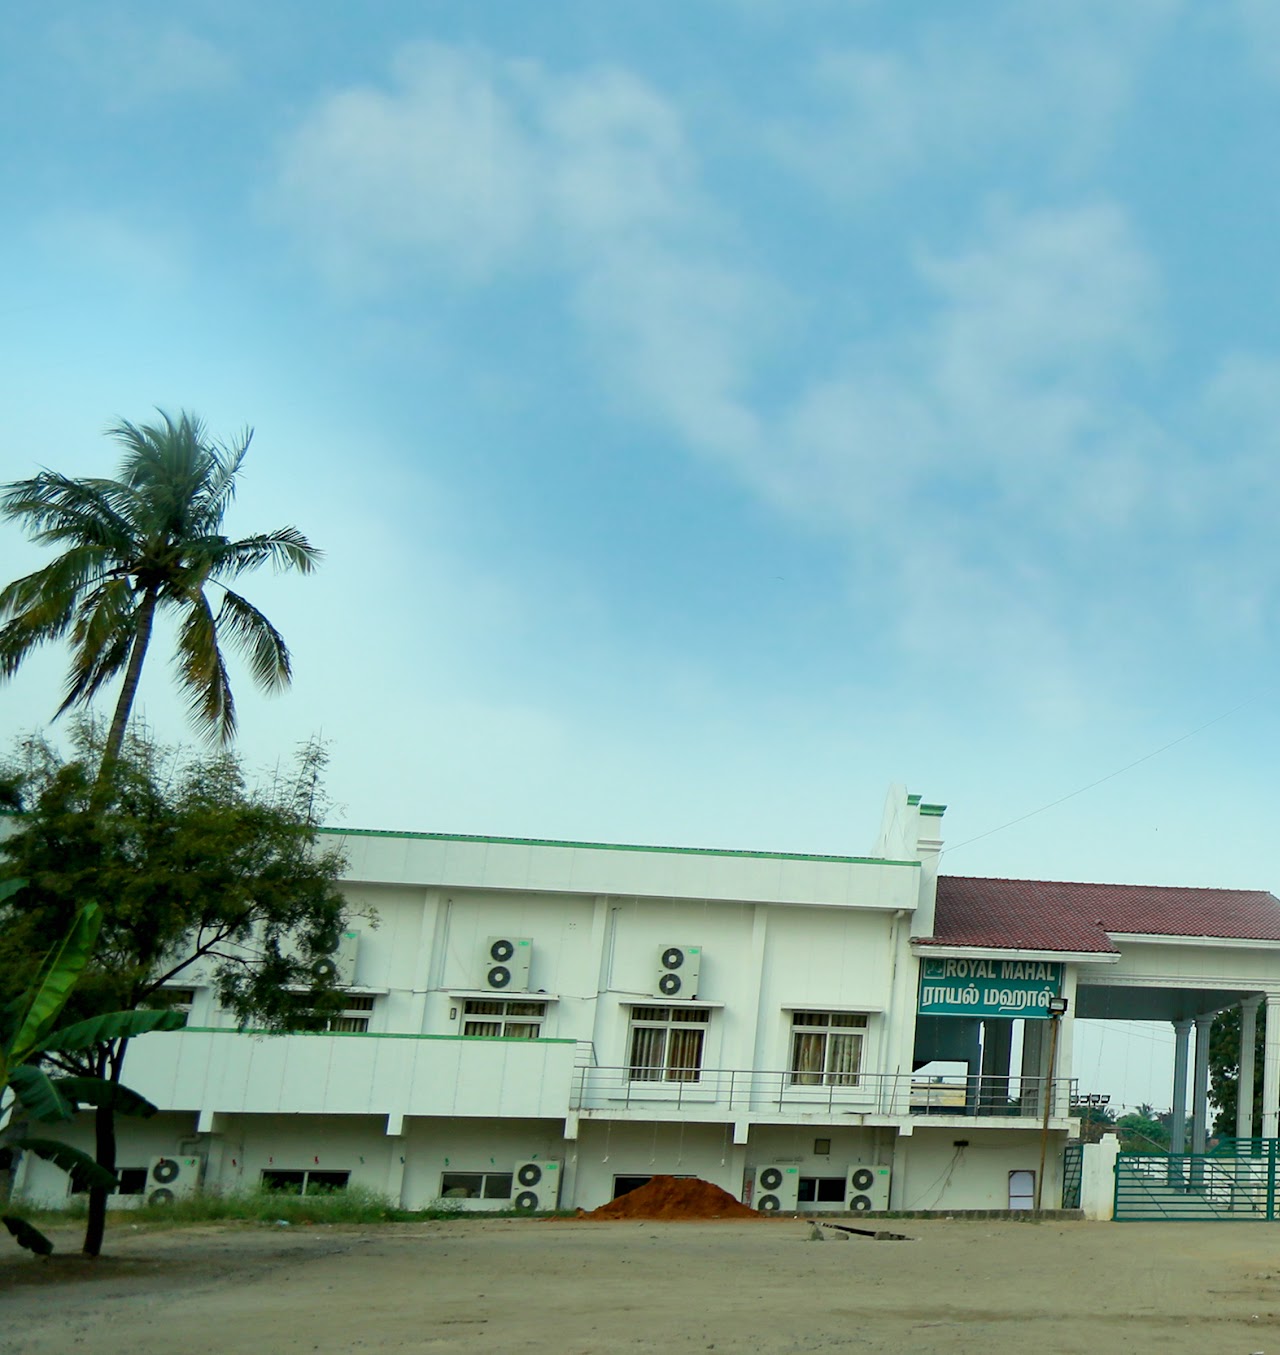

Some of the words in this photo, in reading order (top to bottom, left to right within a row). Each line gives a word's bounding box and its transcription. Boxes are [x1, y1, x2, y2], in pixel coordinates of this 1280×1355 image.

[946, 959, 996, 978] ROYAL
[1001, 961, 1055, 981] MAHAL
[922, 983, 980, 1006] ராயல்
[984, 986, 1055, 1012] மஹால்
